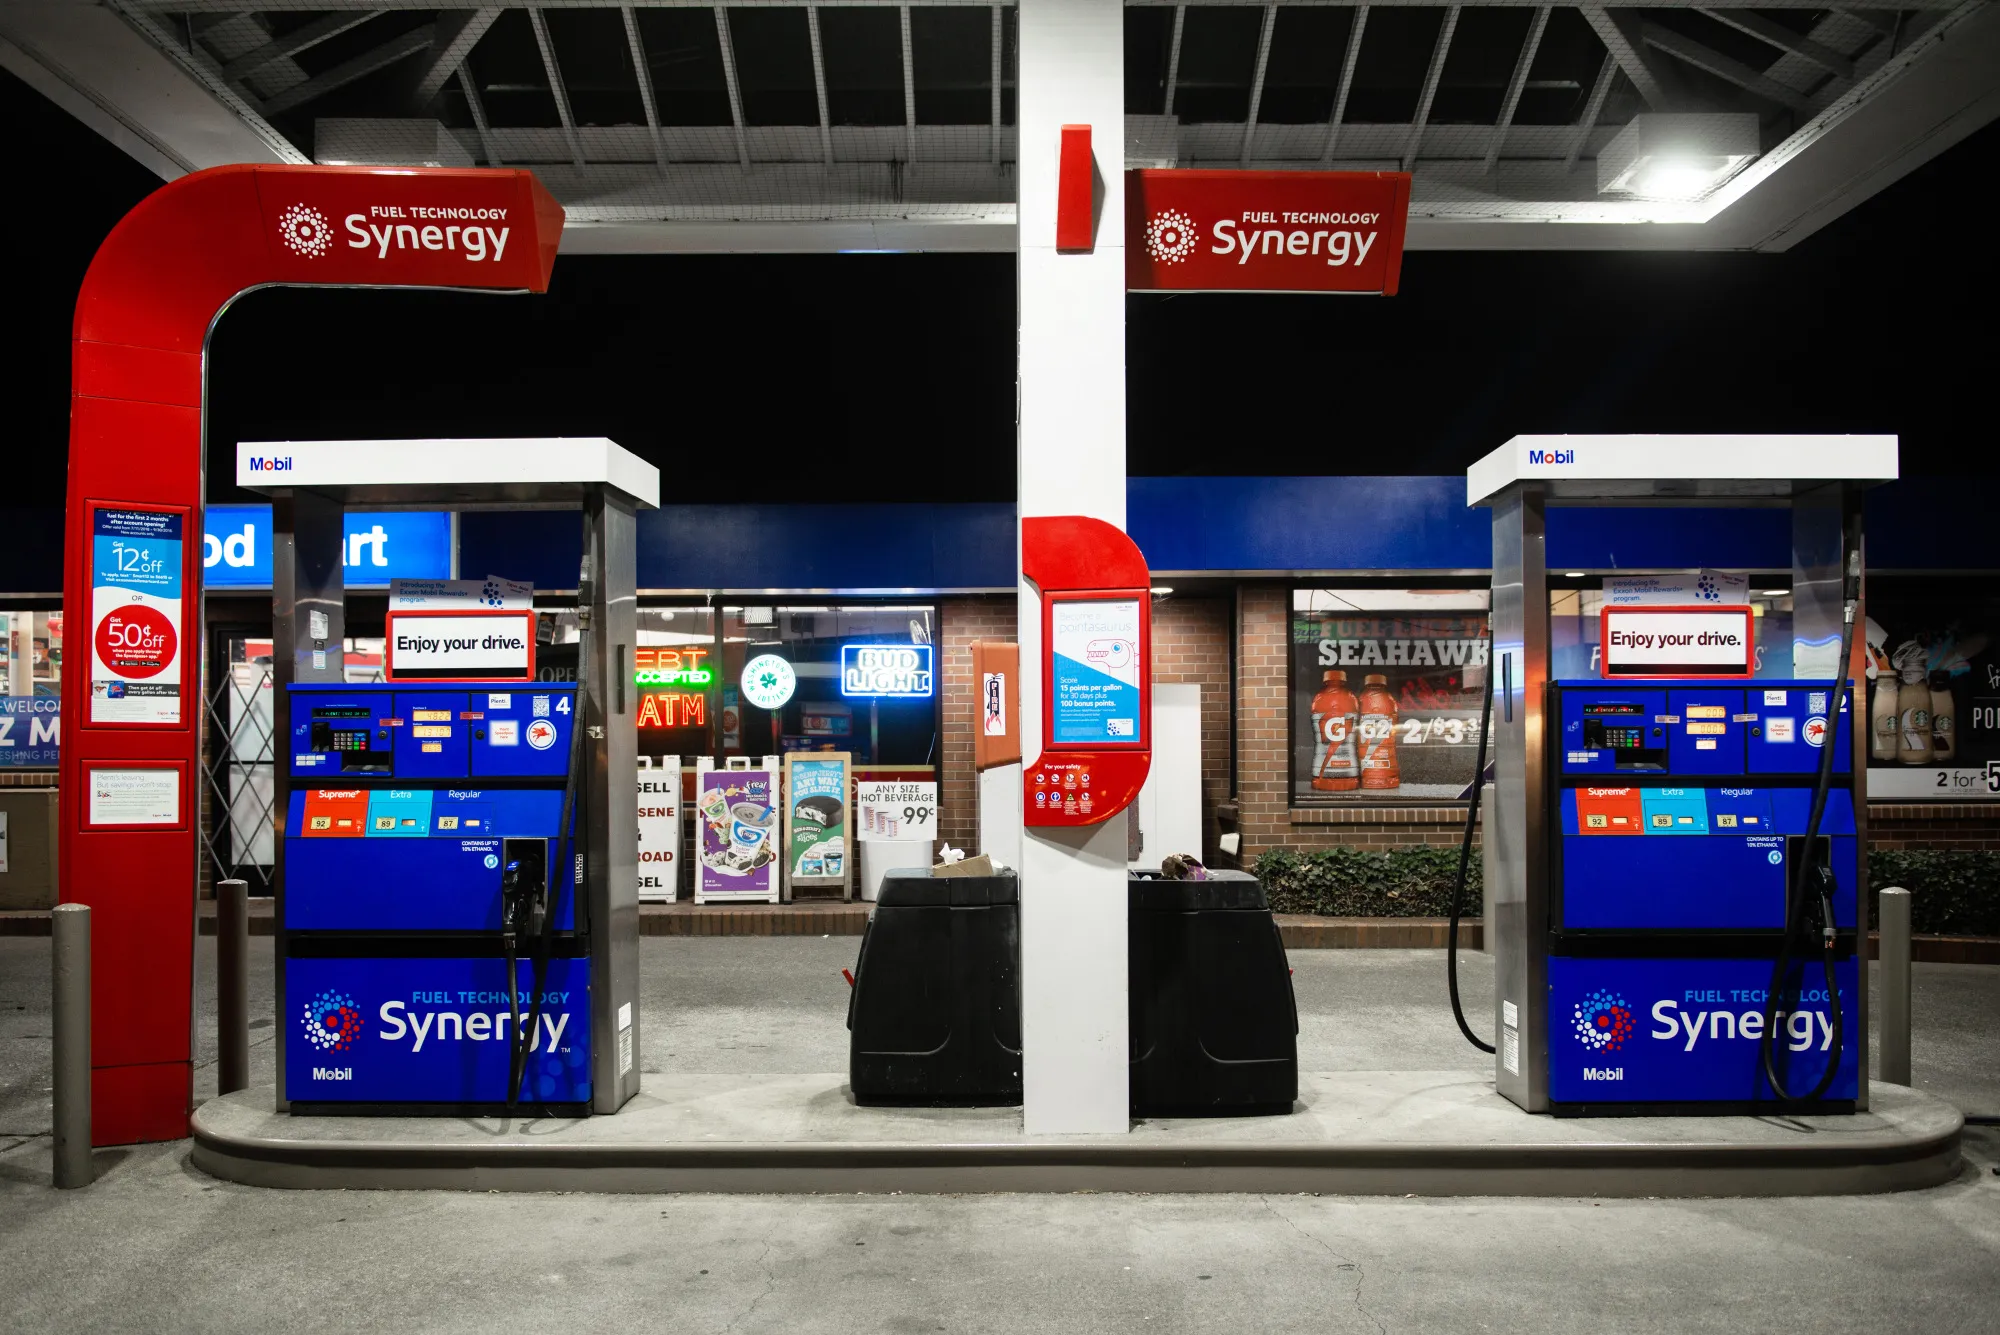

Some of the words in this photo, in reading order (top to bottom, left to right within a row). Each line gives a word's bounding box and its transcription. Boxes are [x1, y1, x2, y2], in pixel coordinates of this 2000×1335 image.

[371, 206, 406, 218] FUEL
[410, 207, 508, 220] TECHNOLOGY
[1242, 212, 1278, 223] FUEL
[1282, 212, 1380, 224] TECHNOLOGY
[345, 214, 510, 262] Synergy
[1212, 220, 1378, 266] Synergy
[250, 457, 292, 470] Mobil
[1530, 450, 1574, 464] Mobil
[398, 636, 440, 653] Enjoy
[444, 639, 478, 652] your
[482, 635, 524, 650] drive.
[1611, 631, 1654, 648] Enjoy
[1658, 634, 1694, 648] your
[1698, 631, 1741, 646] drive.
[636, 651, 706, 671] EBT
[858, 648, 919, 670] BUD
[846, 668, 930, 692] LIGHT
[1103, 684, 1122, 692] gallon
[4, 700, 61, 712] WELCO
[556, 696, 570, 715] 4
[638, 694, 704, 726] ATM
[1325, 716, 1346, 741] G
[796, 778, 816, 788] ANY
[818, 776, 838, 786] WAY
[1937, 772, 1948, 786] 2
[1953, 770, 1976, 787] for
[390, 790, 412, 798] Extra
[448, 790, 482, 800] Regular
[794, 788, 808, 798] YOU
[876, 784, 896, 793] ANY
[900, 784, 920, 793] SIZE
[1721, 788, 1754, 798] Regular
[861, 794, 882, 802] HOT
[884, 794, 934, 802] BEVERAGE
[412, 992, 452, 1004] FUEL
[1685, 990, 1725, 1002] FUEL
[313, 1068, 352, 1080] Mobil
[1584, 1068, 1624, 1080] Mobil
